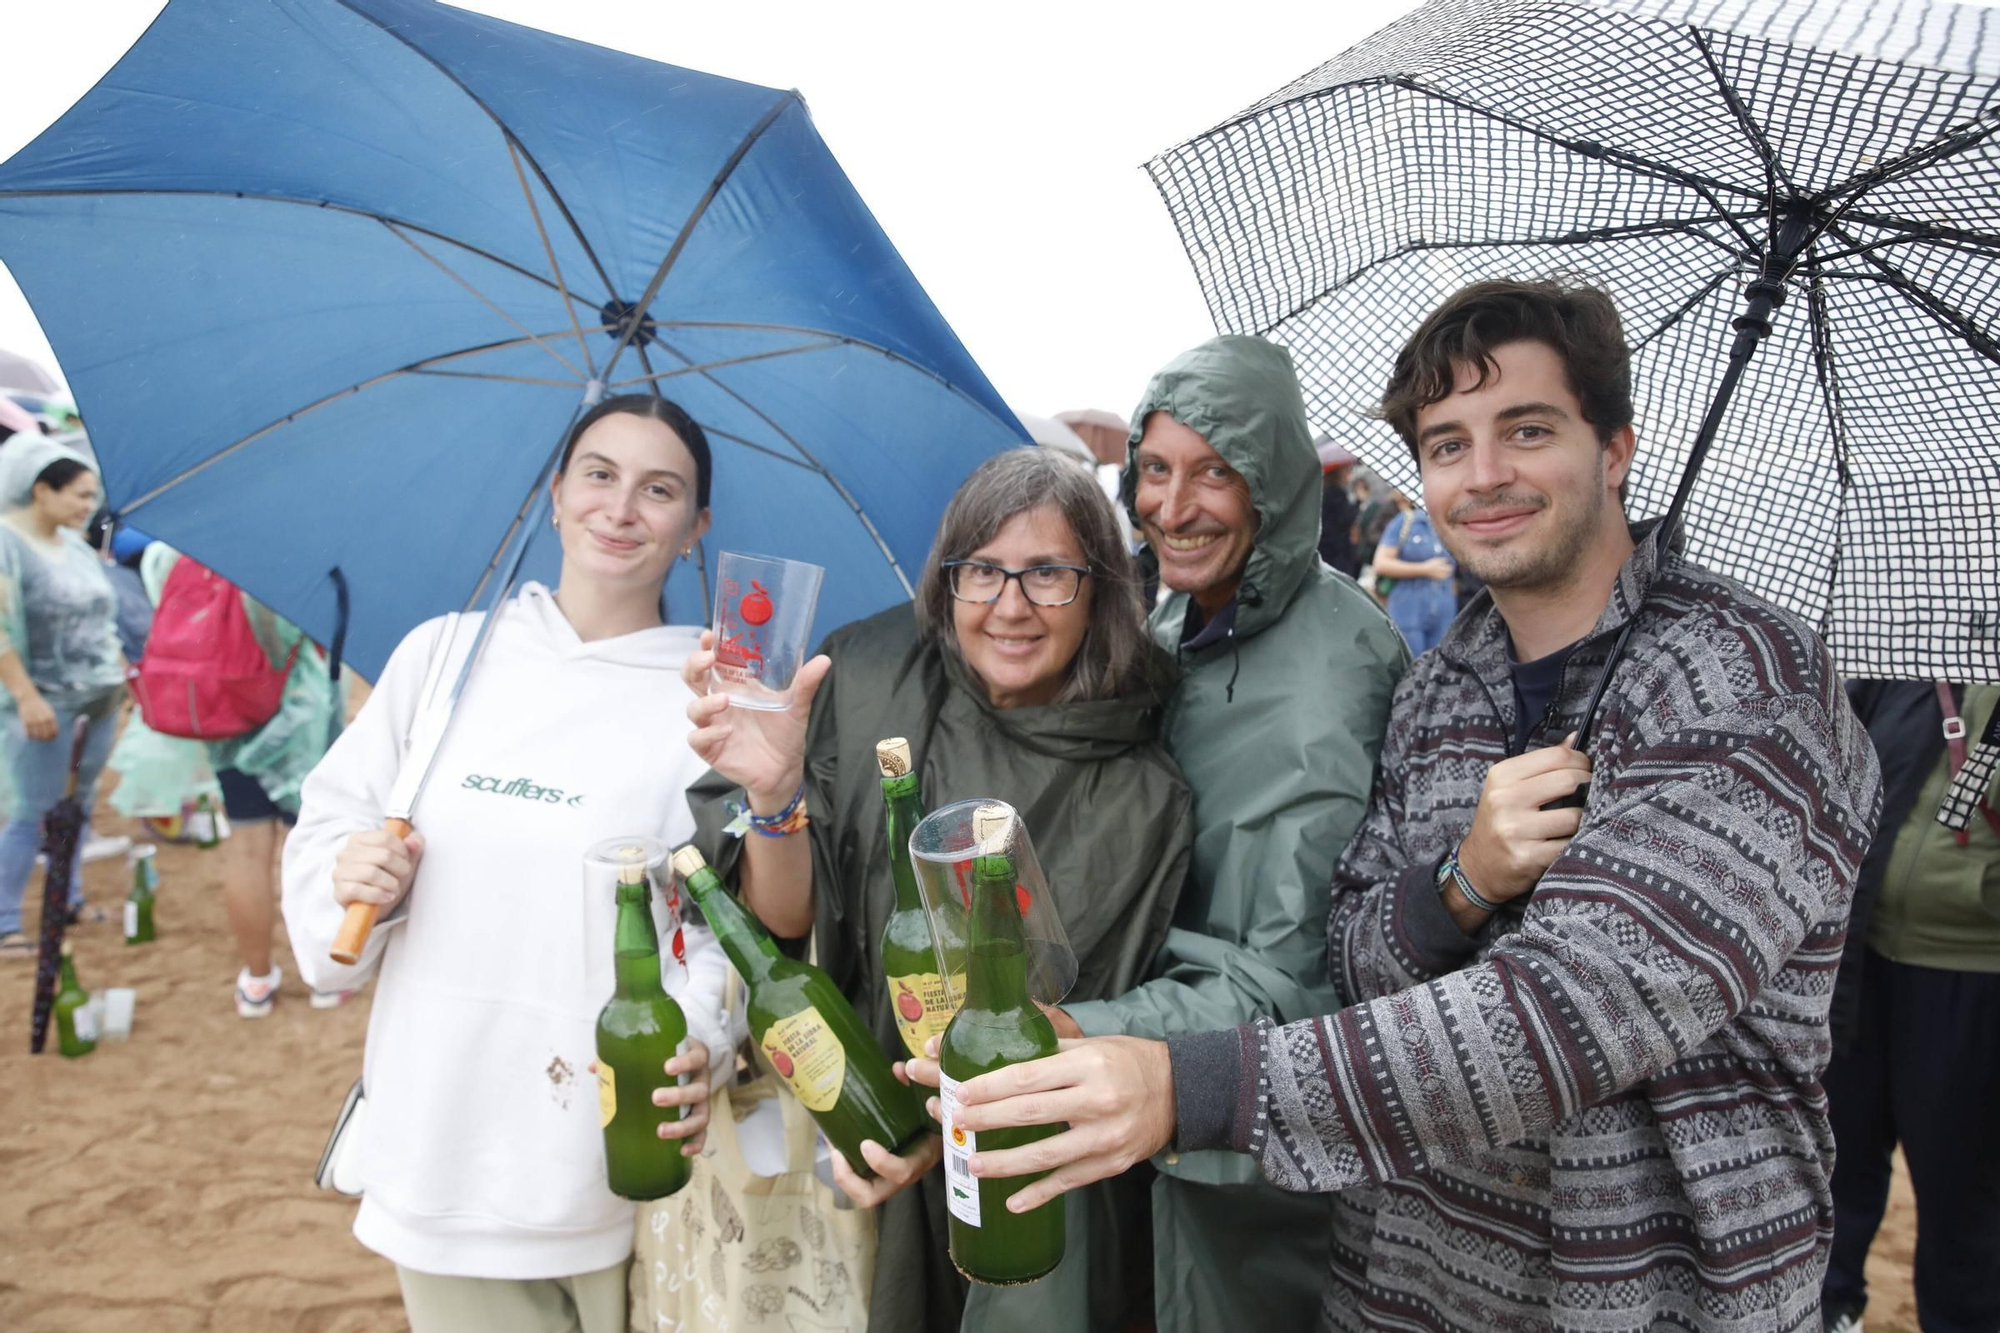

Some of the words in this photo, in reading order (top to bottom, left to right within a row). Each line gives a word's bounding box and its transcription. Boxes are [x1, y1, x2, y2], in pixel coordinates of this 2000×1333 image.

[461, 773, 564, 805] scuffers
[923, 989, 946, 998] FIESTA
[782, 1030, 801, 1046] FIESTA
[795, 1037, 804, 1046] LA
[803, 1024, 822, 1039] SIDRA
